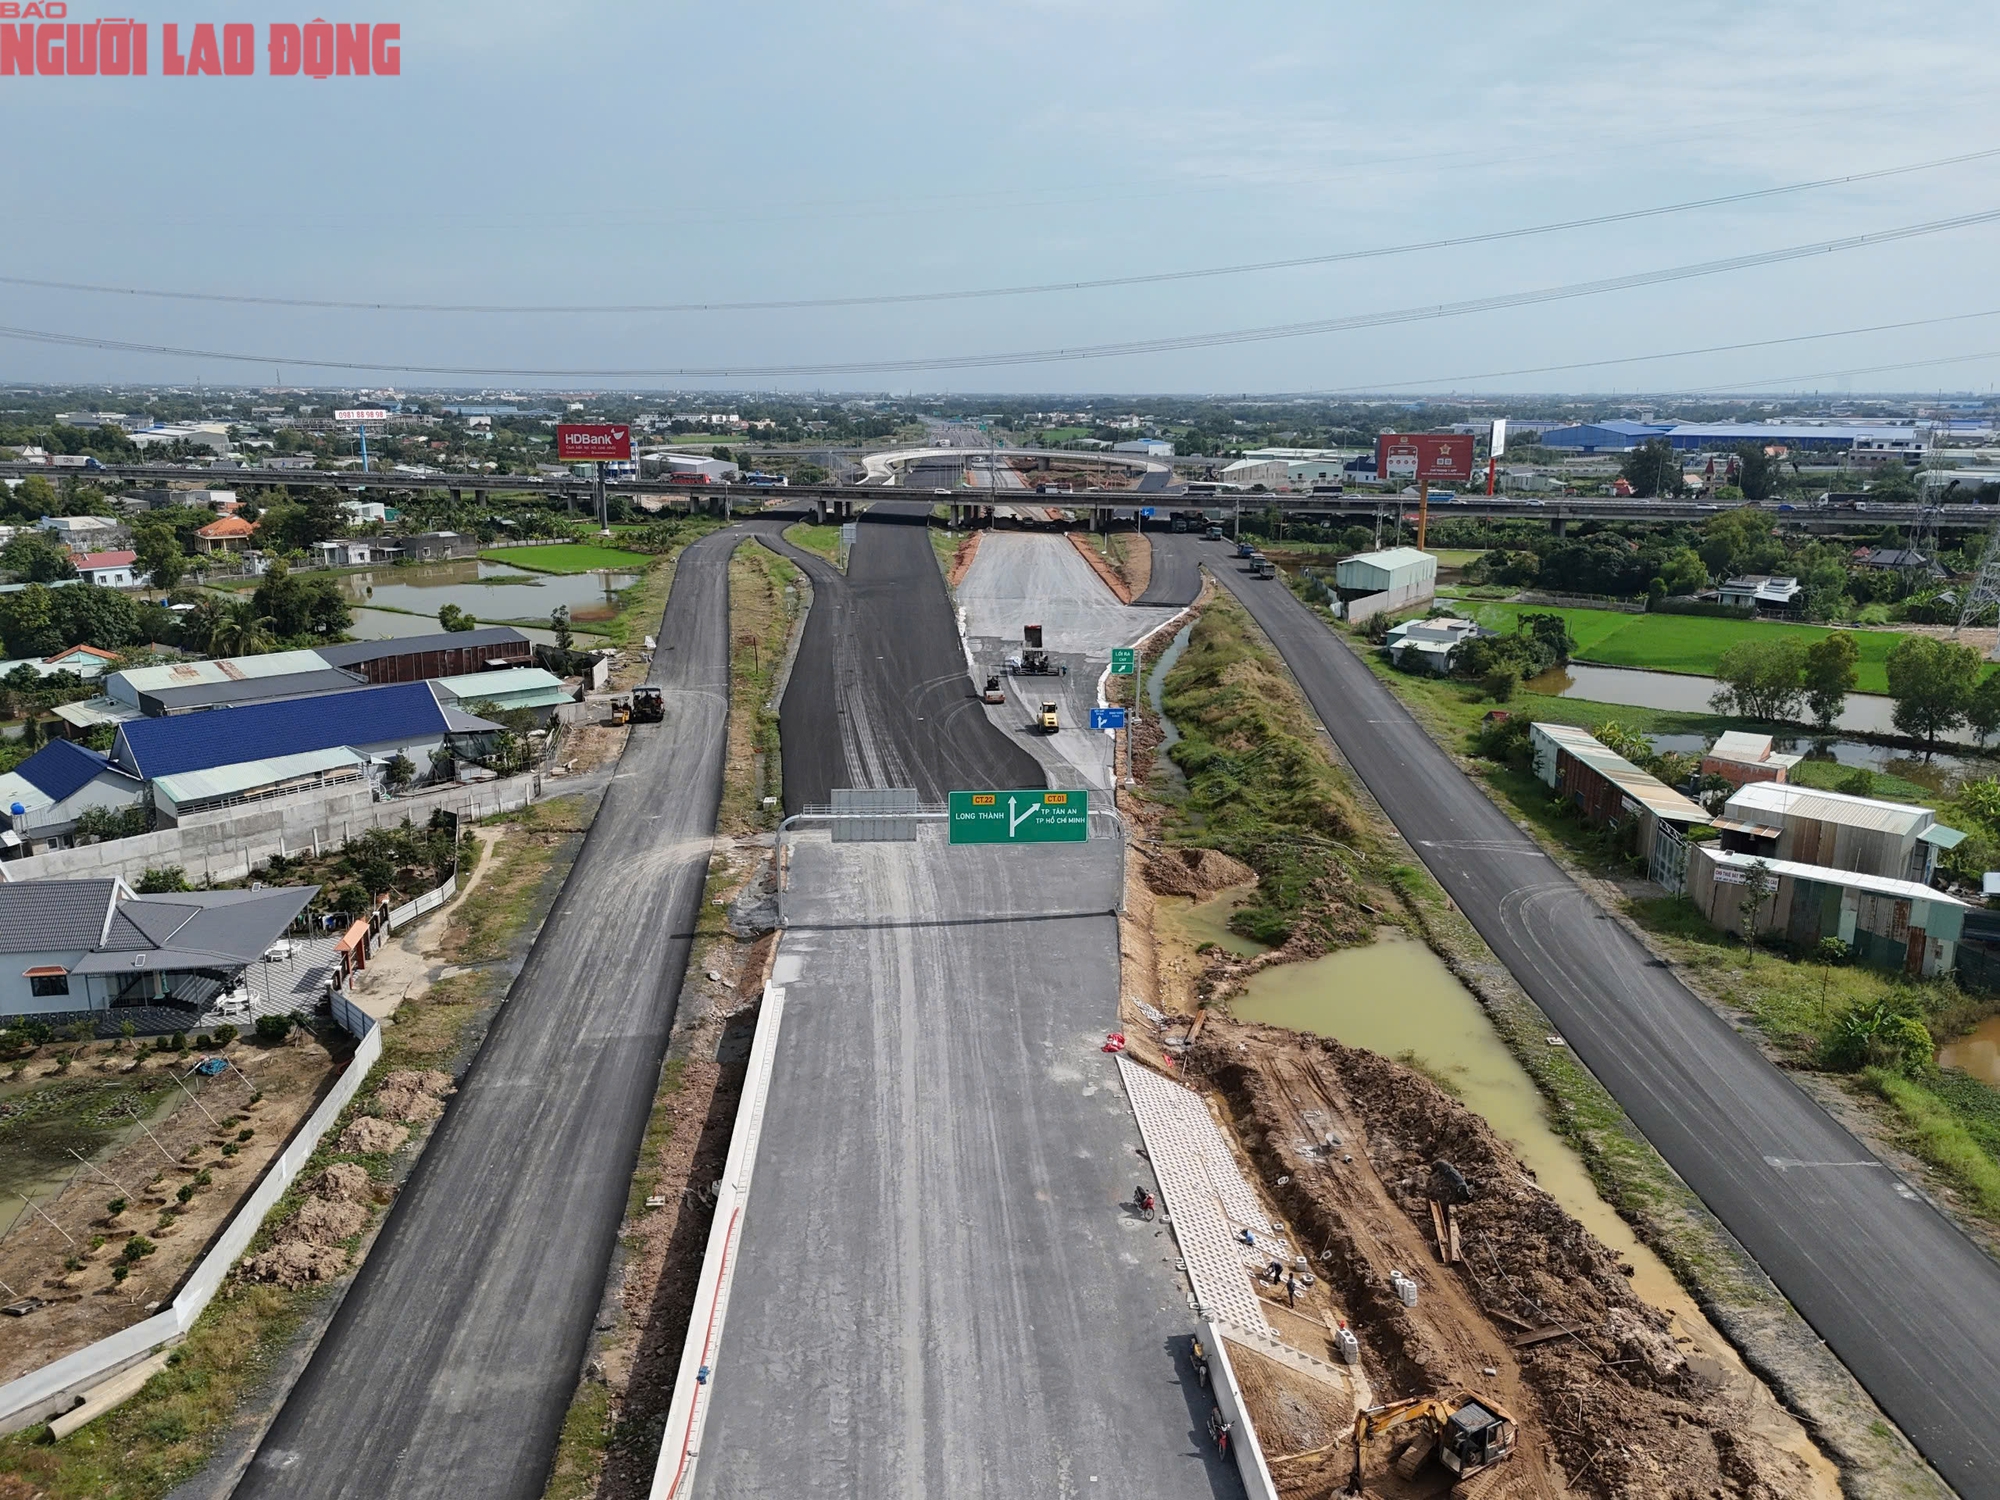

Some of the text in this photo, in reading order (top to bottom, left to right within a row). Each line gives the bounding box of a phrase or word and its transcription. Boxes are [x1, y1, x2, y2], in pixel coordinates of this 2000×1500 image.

[565, 434, 612, 445] HDBank
[955, 811, 1005, 820] LONG THÀNH
[1046, 815, 1055, 824] HỒ
[1056, 816, 1067, 824] CHÍ
